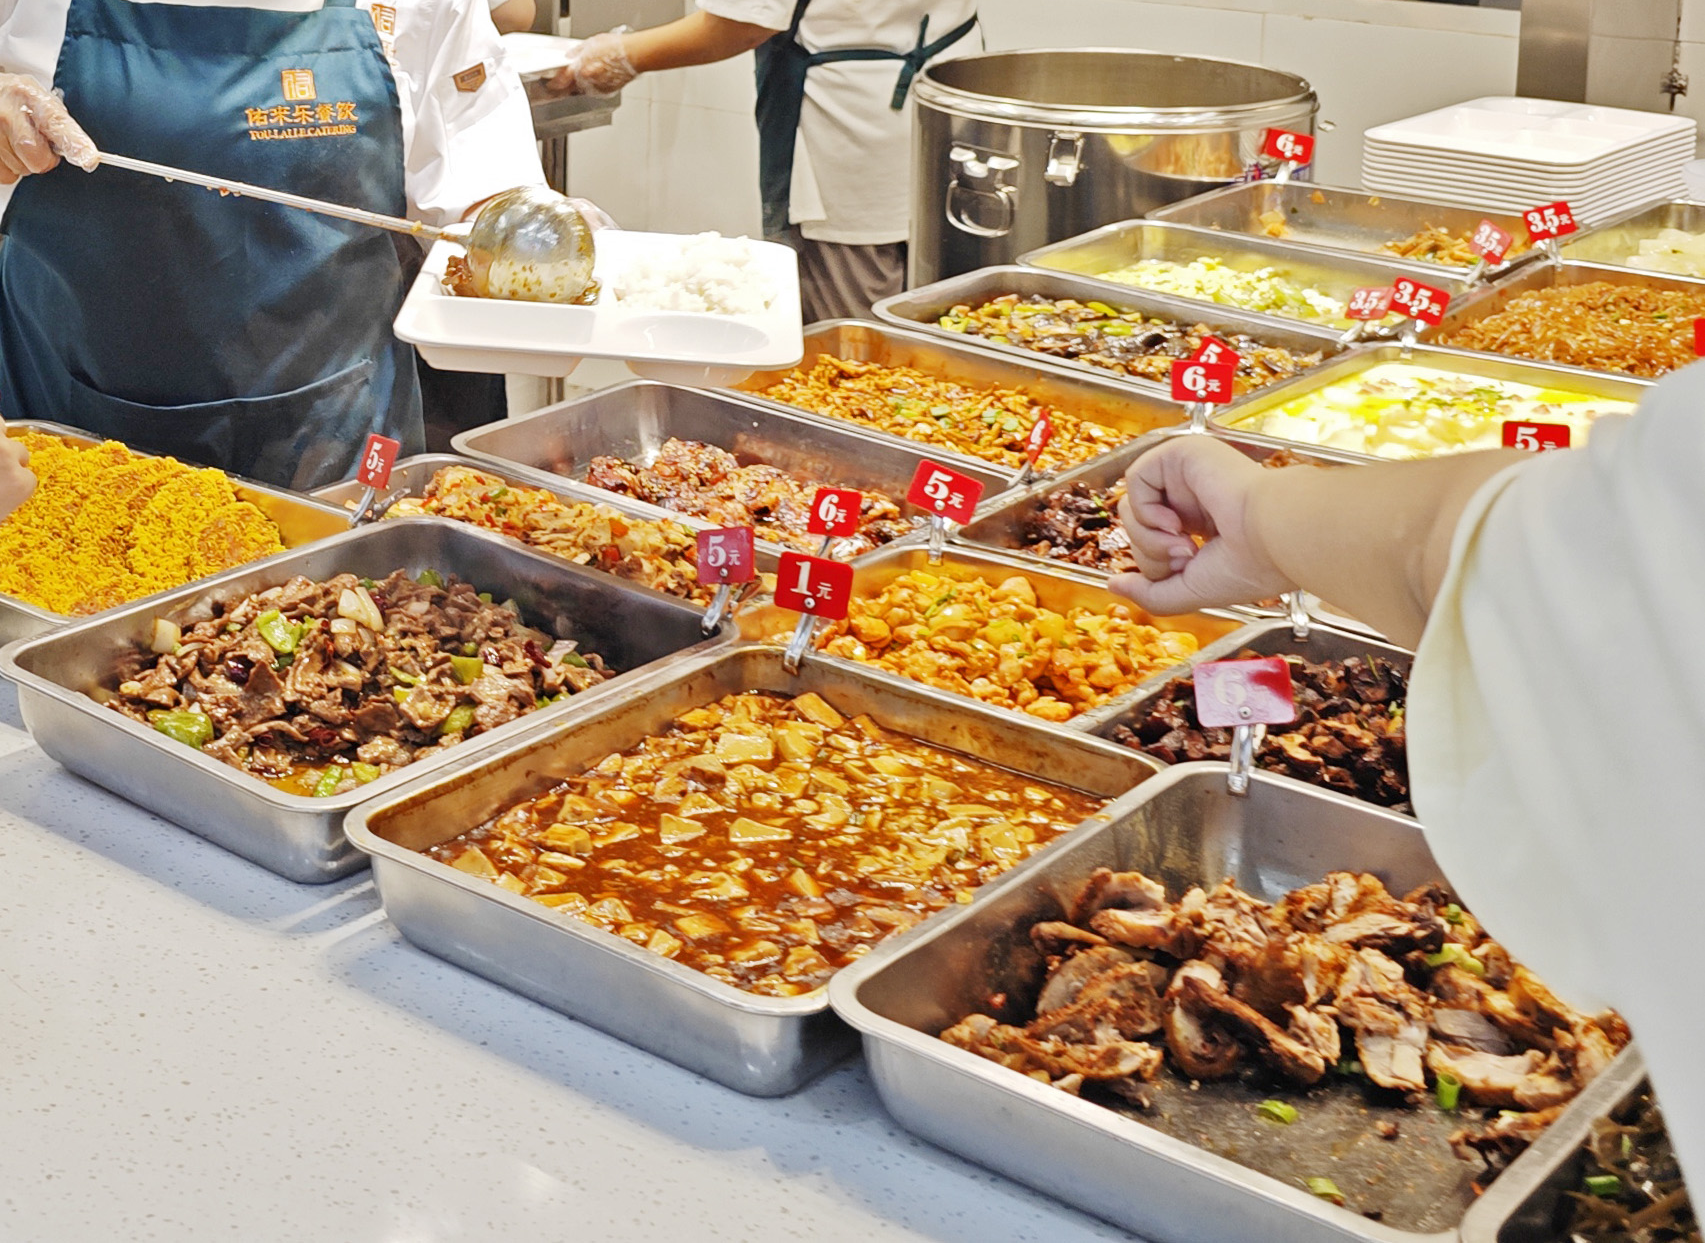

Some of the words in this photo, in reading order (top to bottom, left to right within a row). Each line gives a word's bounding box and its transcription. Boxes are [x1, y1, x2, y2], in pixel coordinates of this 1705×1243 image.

[1182, 366, 1222, 392] 6元
[923, 469, 965, 509] 5元
[818, 493, 848, 523] 6元
[707, 534, 741, 567] 5元
[790, 561, 833, 600] 1元
